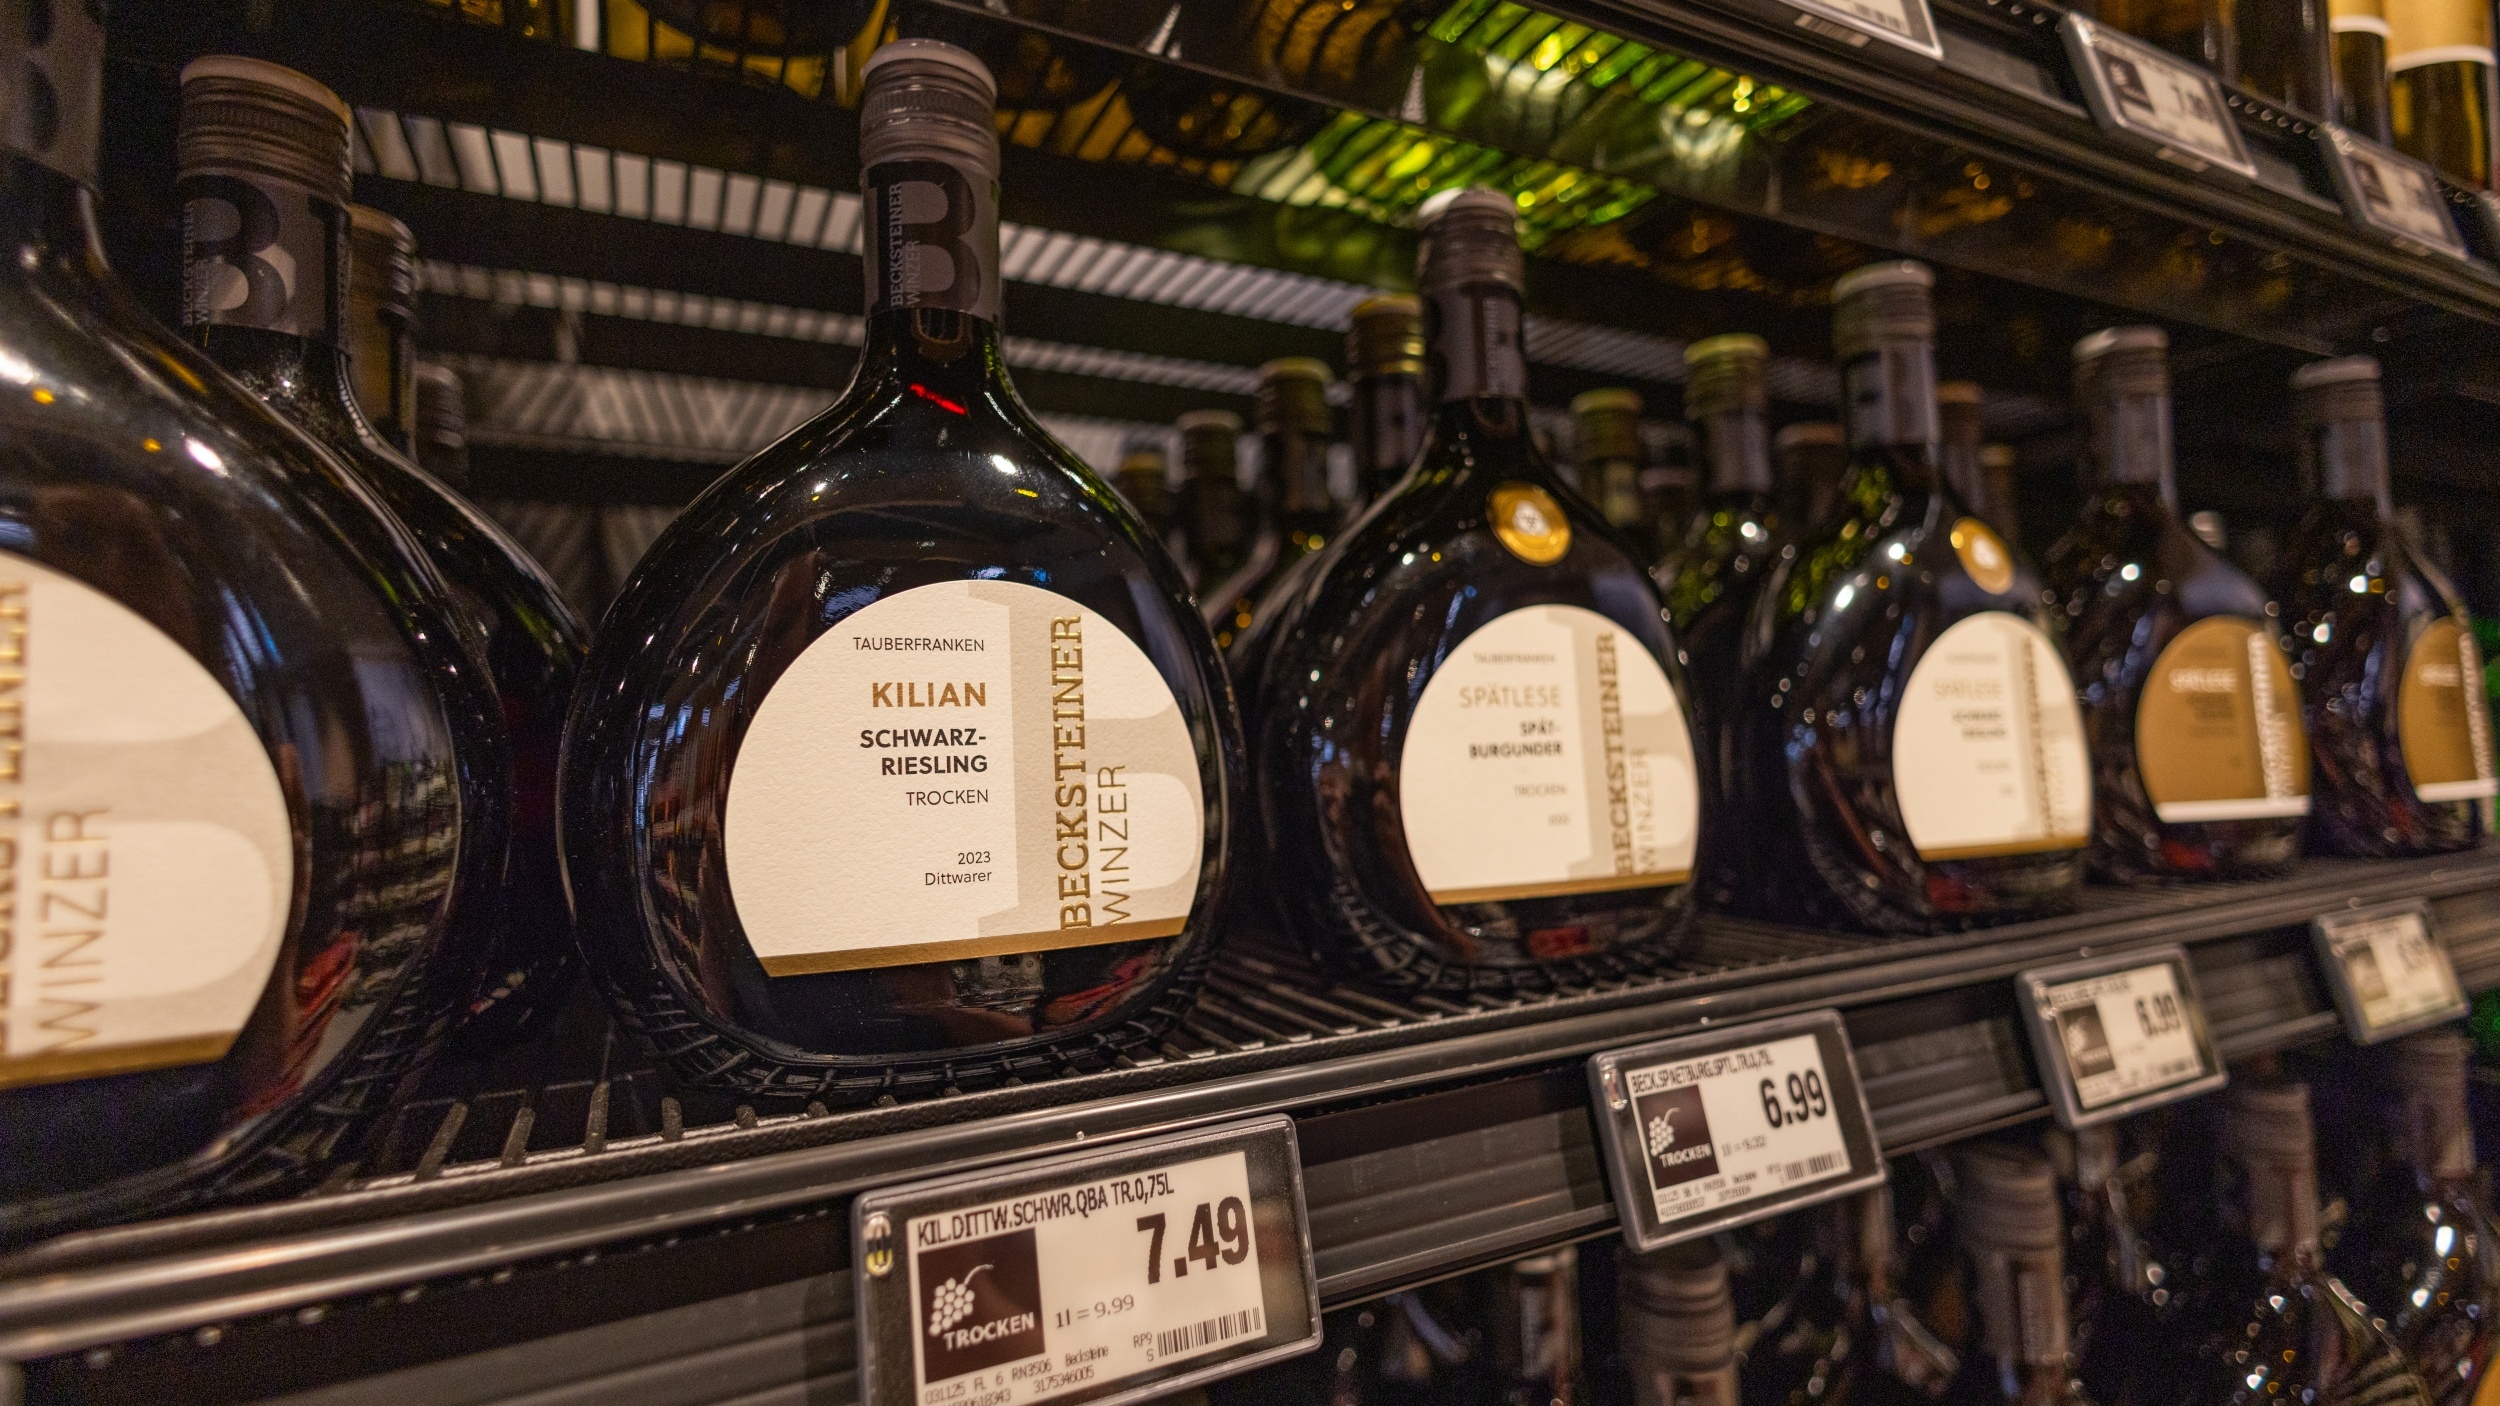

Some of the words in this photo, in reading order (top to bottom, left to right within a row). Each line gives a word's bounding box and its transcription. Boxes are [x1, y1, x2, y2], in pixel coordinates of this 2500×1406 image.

[889, 182, 903, 307] BECKSTEINER
[906, 239, 921, 306] WINZER
[853, 636, 985, 652] TAUBERFRANKEN
[872, 682, 987, 708] KILIAN
[1458, 682, 1562, 709] SPÄTLESE
[859, 728, 987, 749] SCHWARZ-
[1469, 741, 1563, 759] BURGUNDER
[881, 755, 989, 776] RIESLING
[1596, 631, 1634, 877] BECKSTEINER
[1050, 613, 1092, 931] BECKSTEINER
[906, 788, 989, 807] TROCKEN
[957, 850, 992, 866] 2023
[1098, 764, 1131, 927] WINZER
[925, 869, 992, 886] Dittwarer
[37, 806, 111, 1051] WINZER
[1758, 1068, 1828, 1129] 6.99
[1659, 1142, 1713, 1168] TROCKEN
[918, 1185, 1108, 1247] KIL.DITTW.SCHWR.QBA
[1111, 1172, 1175, 1205] TR.0,75L
[1137, 1196, 1249, 1285] 7.49
[1094, 1294, 1135, 1317] 9.99
[943, 1311, 1035, 1351] TROCKEN
[996, 1371, 1004, 1385] 6
[1011, 1358, 1052, 1381] RN3506
[1034, 1364, 1095, 1394] 3175346005
